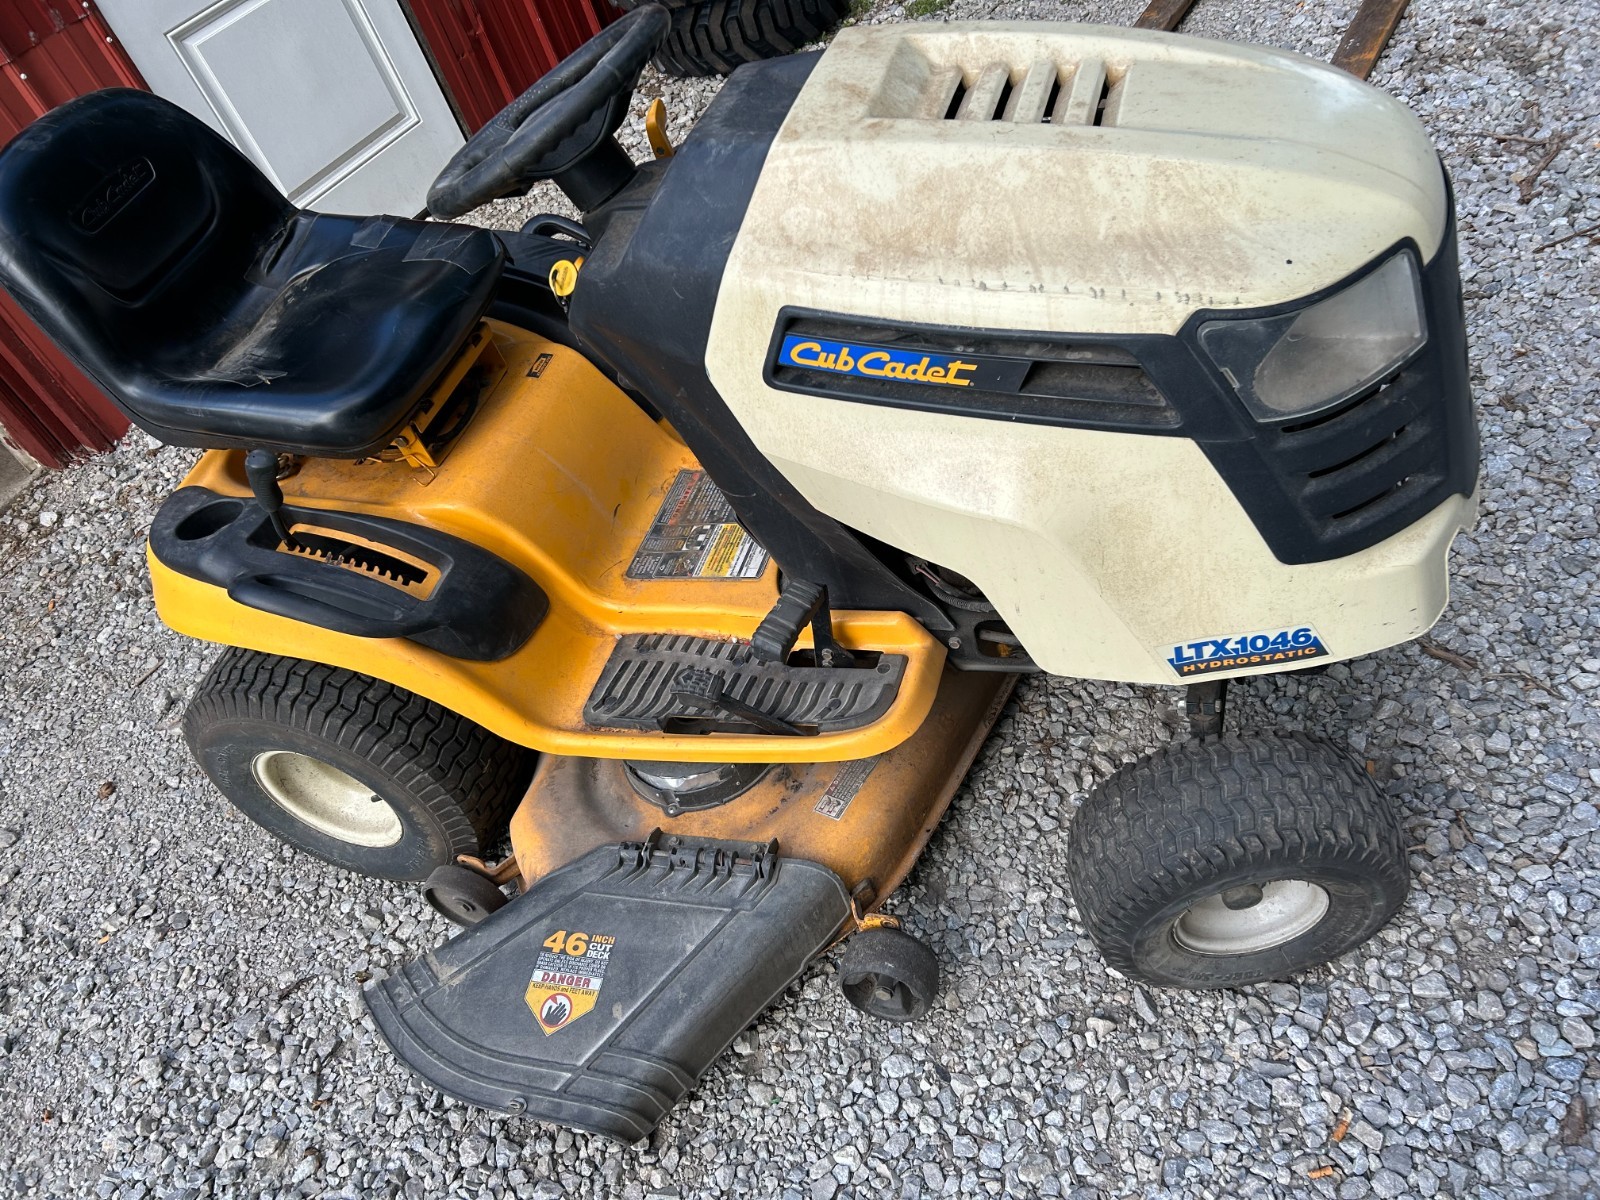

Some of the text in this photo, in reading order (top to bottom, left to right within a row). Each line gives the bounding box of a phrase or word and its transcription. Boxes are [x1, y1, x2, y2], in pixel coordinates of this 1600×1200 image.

[789, 341, 978, 387] Cub Cadet
[1173, 627, 1313, 664] LTX1046
[1183, 647, 1317, 673] HYDROSTATIC
[543, 930, 589, 955] 46
[589, 943, 613, 952] CUT
[592, 935, 616, 944] INCH
[586, 950, 611, 960] DECK
[541, 972, 592, 988] DANGER
[581, 989, 596, 997] AWAY
